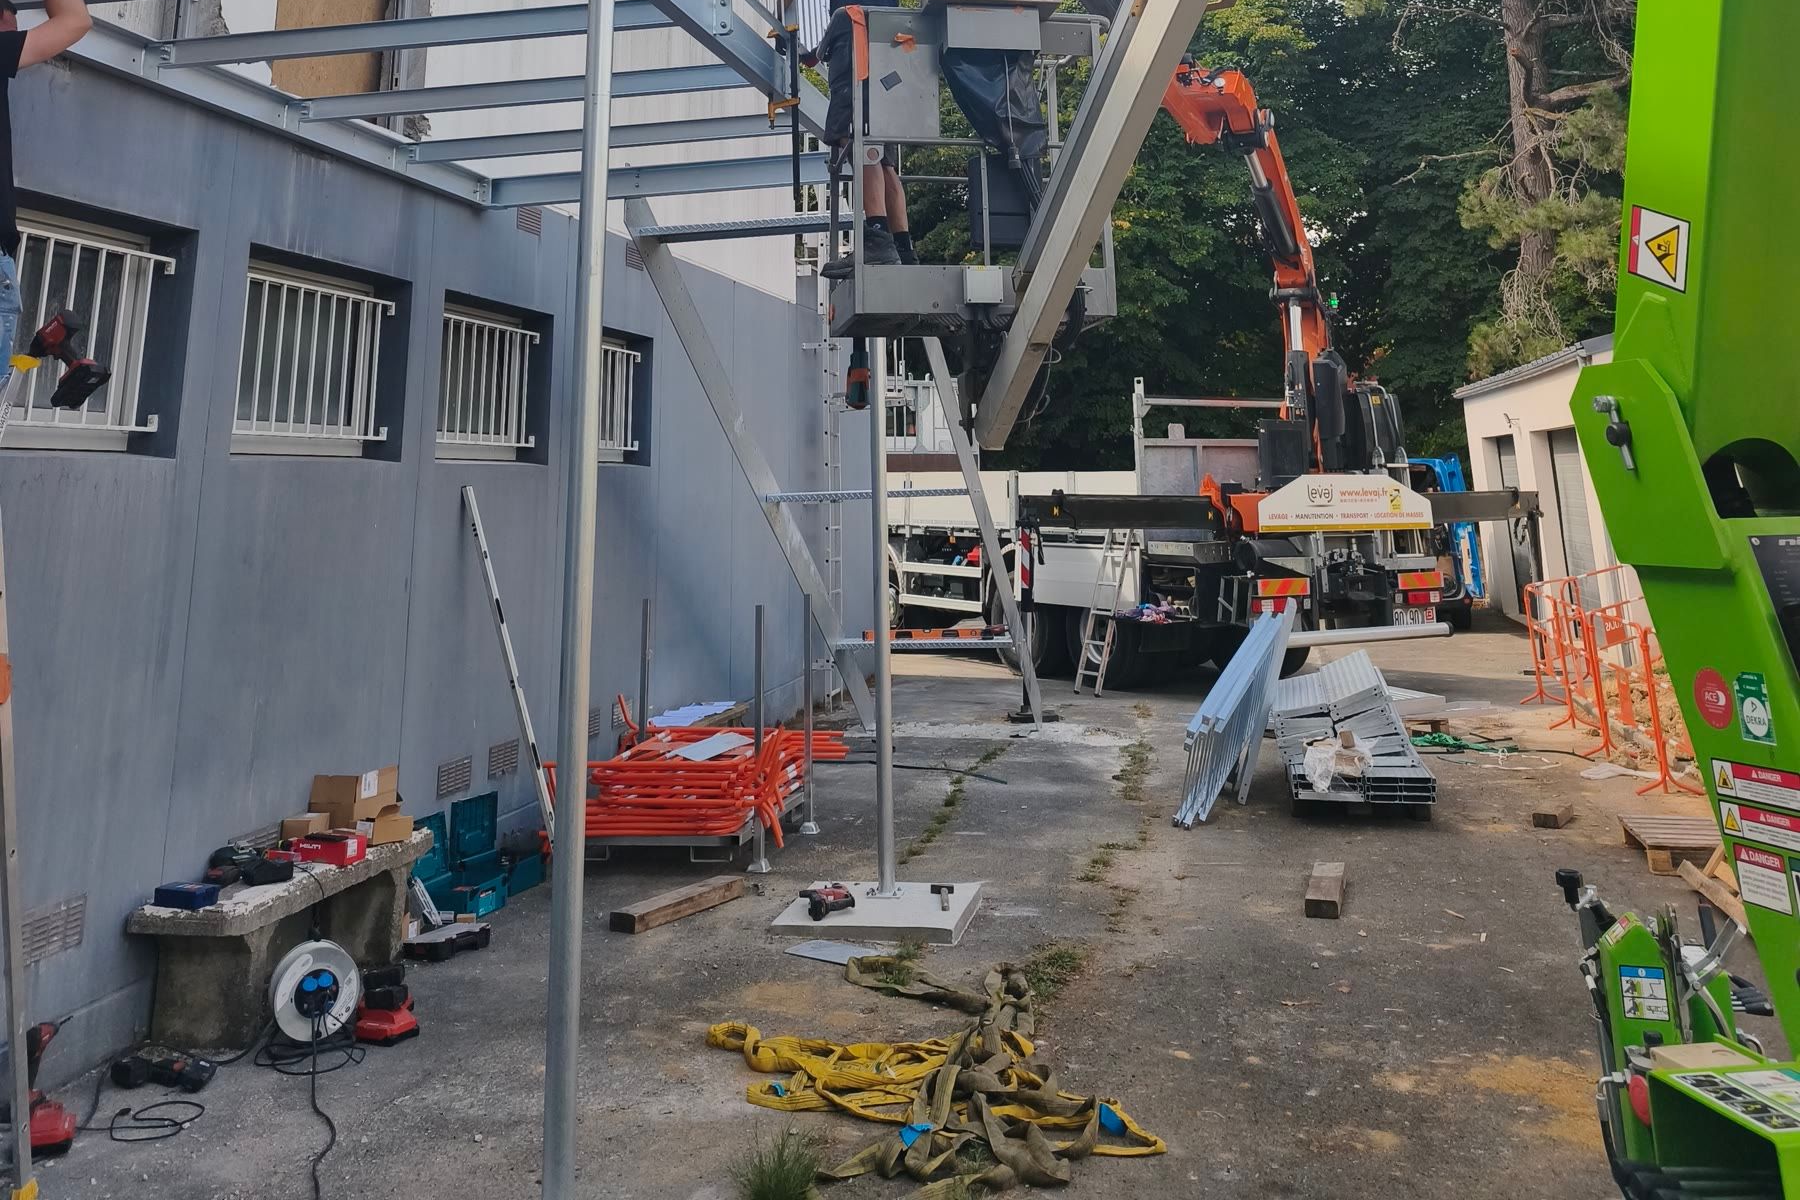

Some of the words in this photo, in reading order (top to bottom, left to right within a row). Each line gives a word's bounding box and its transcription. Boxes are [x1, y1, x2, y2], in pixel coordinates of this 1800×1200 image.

[1339, 488, 1388, 499] www.levaj.fr
[1295, 512, 1334, 520] MANUTENTION
[1704, 691, 1719, 703] ACE
[1745, 714, 1767, 726] DEKRA
[1757, 770, 1782, 783] DANGER
[1766, 814, 1791, 829] DANGER
[1749, 850, 1781, 869] DANGER
